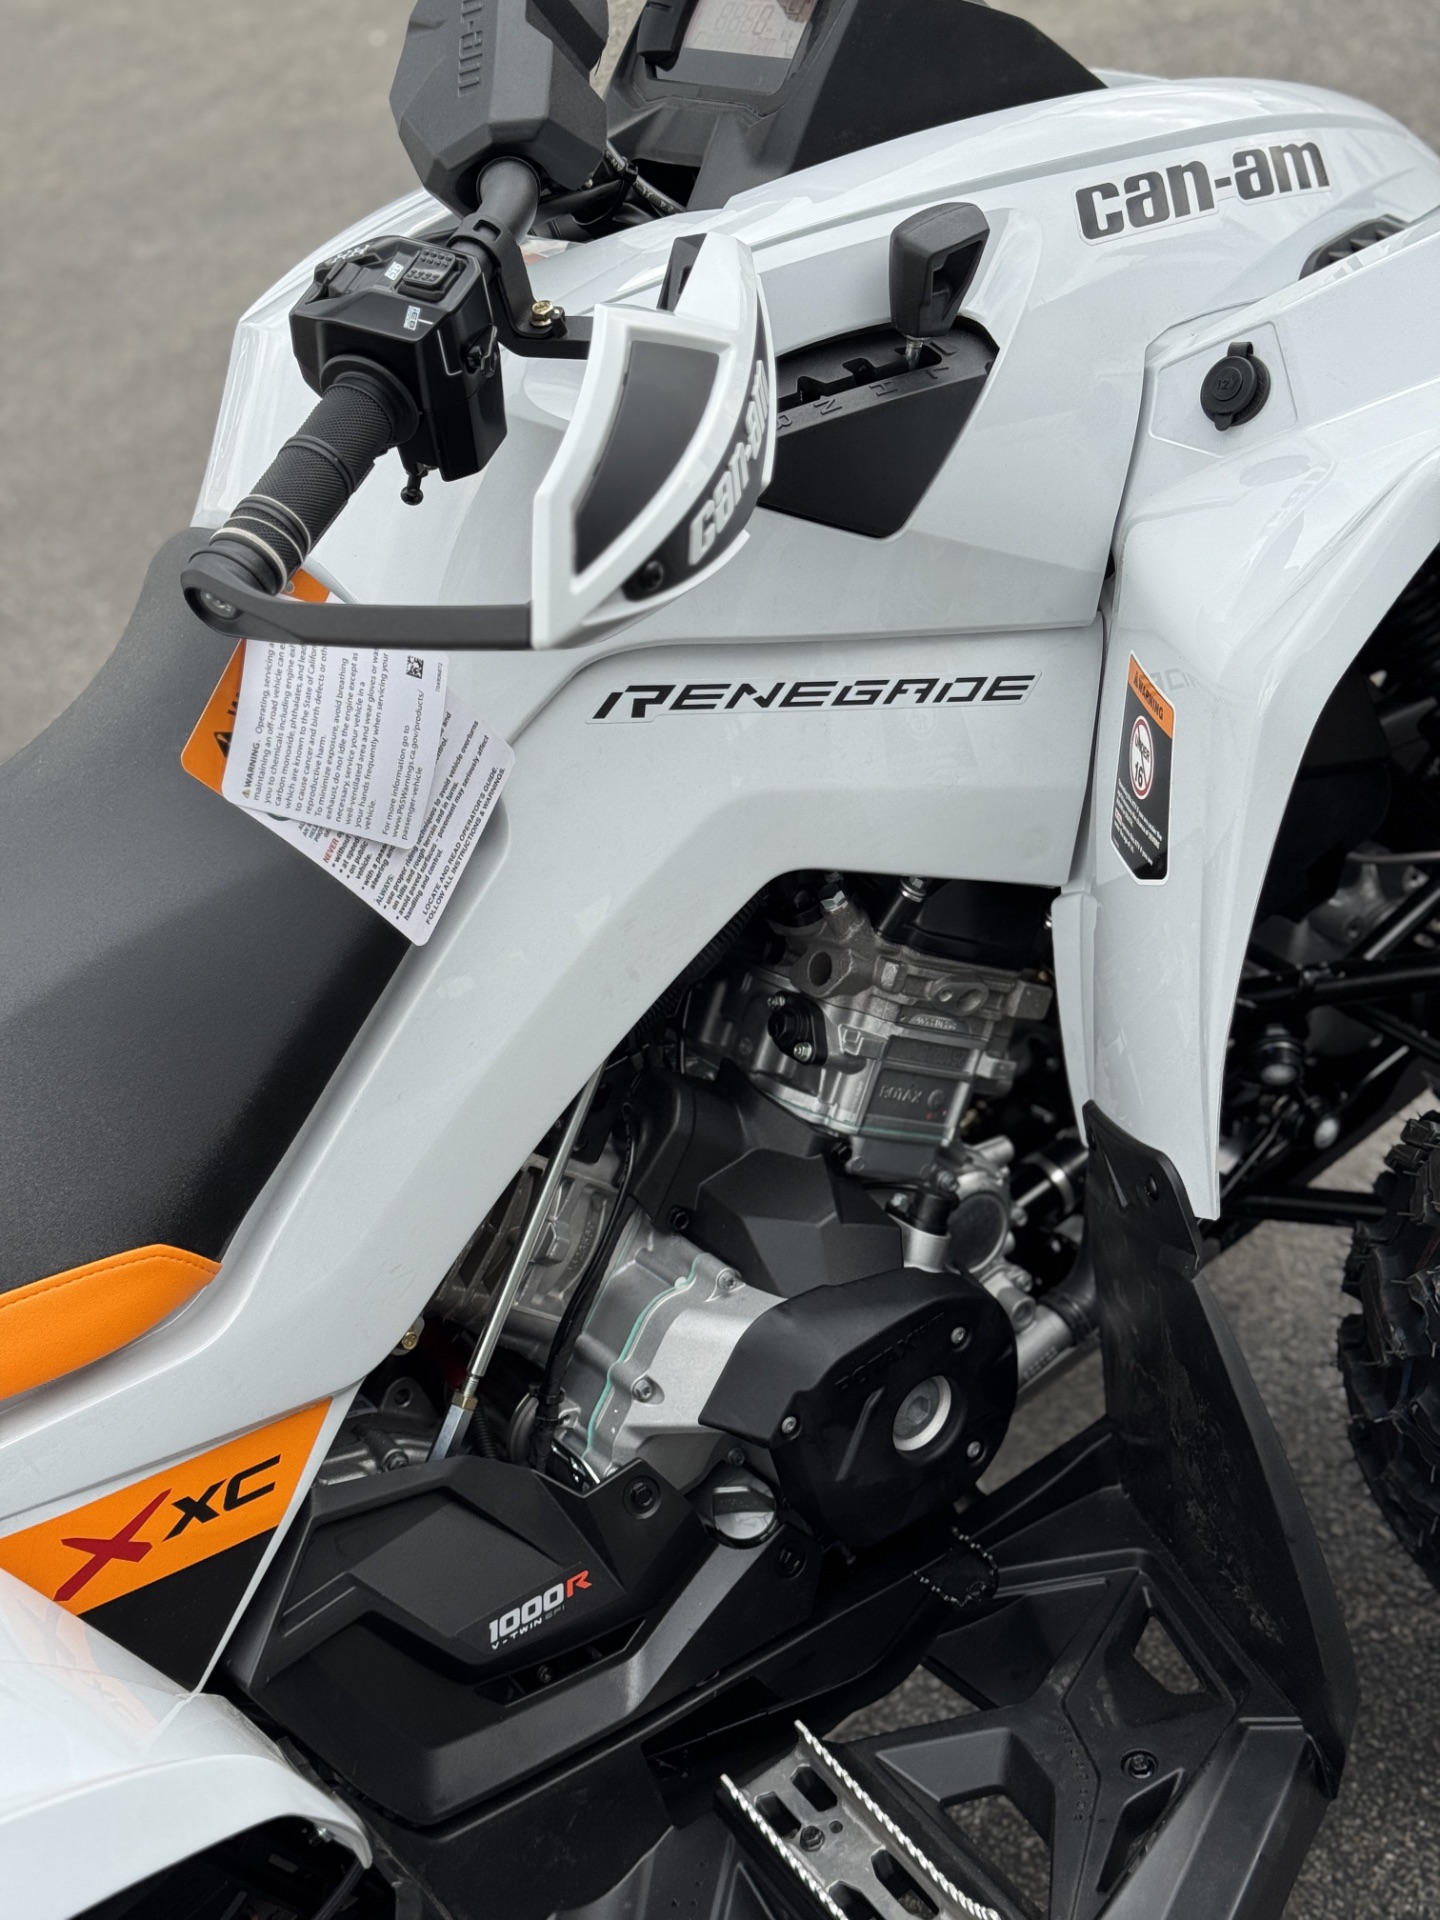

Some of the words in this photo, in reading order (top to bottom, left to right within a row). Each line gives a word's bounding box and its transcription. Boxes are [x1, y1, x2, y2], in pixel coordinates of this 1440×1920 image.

[1076, 142, 1330, 240] can-am
[319, 662, 325, 672] or
[320, 645, 328, 661] oth
[352, 652, 358, 661] as
[372, 648, 380, 663] wa
[273, 668, 282, 698] vehicle
[285, 659, 294, 689] engine
[306, 674, 313, 685] of
[335, 657, 348, 698] breathing
[348, 662, 357, 690] except
[371, 664, 377, 674] or
[302, 686, 312, 708] State
[314, 674, 324, 704] defects
[357, 688, 364, 696] in
[367, 675, 376, 702] gloves
[376, 673, 388, 710] servicing
[592, 674, 1036, 720] RENEGADE
[1138, 675, 1164, 720] WARNING
[244, 742, 259, 787] WARNING.
[254, 690, 270, 734] Operating,
[264, 649, 275, 687] servicing
[266, 699, 278, 734] off-road
[277, 690, 291, 730] including
[300, 709, 309, 724] the
[310, 706, 319, 727] birth
[333, 699, 342, 723] avoid
[344, 692, 353, 721] engine
[353, 697, 363, 727] vehicle
[364, 703, 372, 724] wear
[441, 711, 451, 727] and
[299, 725, 306, 734] to
[308, 727, 316, 745] and
[341, 722, 349, 736] the
[361, 725, 369, 742] and
[372, 711, 381, 735] when
[403, 724, 410, 733] to
[265, 736, 271, 747] an
[274, 776, 286, 806] carbon
[289, 682, 302, 729] phthalates,
[292, 736, 304, 766] known
[326, 725, 338, 764] exposure,
[337, 738, 346, 754] idle
[350, 728, 358, 748] your
[401, 735, 409, 747] go
[270, 732, 283, 774] chemicals
[303, 746, 312, 774] cancer
[344, 749, 355, 778] service
[358, 743, 366, 762] area
[363, 736, 378, 779] frequently
[253, 748, 271, 800] maintaining
[267, 776, 275, 785] to
[305, 760, 321, 814] reproductive
[315, 736, 325, 758] harm.
[318, 766, 331, 805] minimize
[332, 771, 340, 784] do
[391, 748, 405, 796] information
[1135, 761, 1143, 788] 16
[264, 787, 272, 803] you
[285, 783, 295, 808] which
[298, 776, 307, 800] cause
[325, 785, 338, 819] exhaust,
[335, 780, 350, 822] necessary,
[345, 763, 362, 824] well-ventilated
[357, 781, 369, 807] hands
[294, 802, 302, 811] to
[313, 806, 322, 816] To
[364, 799, 376, 829] vehicle.
[385, 890, 394, 904] use
[393, 866, 407, 891] proper
[405, 845, 418, 866] riding
[433, 798, 441, 806] to
[438, 777, 450, 798] avoid
[448, 753, 462, 777] vehicle
[460, 720, 478, 753] overturns
[386, 798, 396, 820] more
[401, 767, 422, 840] passenger-vehicle
[354, 808, 363, 828] your
[381, 821, 390, 835] For
[398, 894, 410, 915] avoid
[408, 872, 421, 895] paved
[420, 843, 436, 872] surfaces
[437, 802, 456, 838] pavement
[454, 787, 464, 803] may
[462, 756, 479, 787] seriously
[477, 734, 488, 756] affect
[322, 837, 338, 863] NEVER
[334, 833, 353, 862] without
[392, 900, 399, 910] on
[396, 884, 407, 900] hills
[405, 868, 415, 883] and
[412, 847, 425, 869] rough
[422, 824, 437, 847] terrain
[435, 808, 444, 823] and
[441, 801, 448, 809] in
[445, 782, 458, 801] turns.
[422, 882, 441, 915] LOCATE
[439, 865, 449, 883] AND
[447, 841, 461, 864] READ
[459, 792, 487, 841] OPERATOR'S
[483, 766, 500, 792] GUIDE.
[425, 890, 444, 924] FOLLOW
[443, 876, 453, 890] ALL
[448, 817, 481, 873] INSTRUCTIONS
[479, 768, 504, 809] WARNINGS.
[341, 859, 349, 868] at
[348, 864, 356, 874] on
[354, 840, 370, 864] public
[355, 853, 371, 879] vehicle.
[363, 869, 374, 885] with
[370, 858, 389, 889] steering
[403, 889, 423, 920] handling
[420, 874, 429, 889] and
[427, 849, 443, 875] control.
[375, 874, 394, 905] ALWAYS:
[489, 1569, 592, 1644] 1000R
[491, 1617, 543, 1650] V-TWIN
